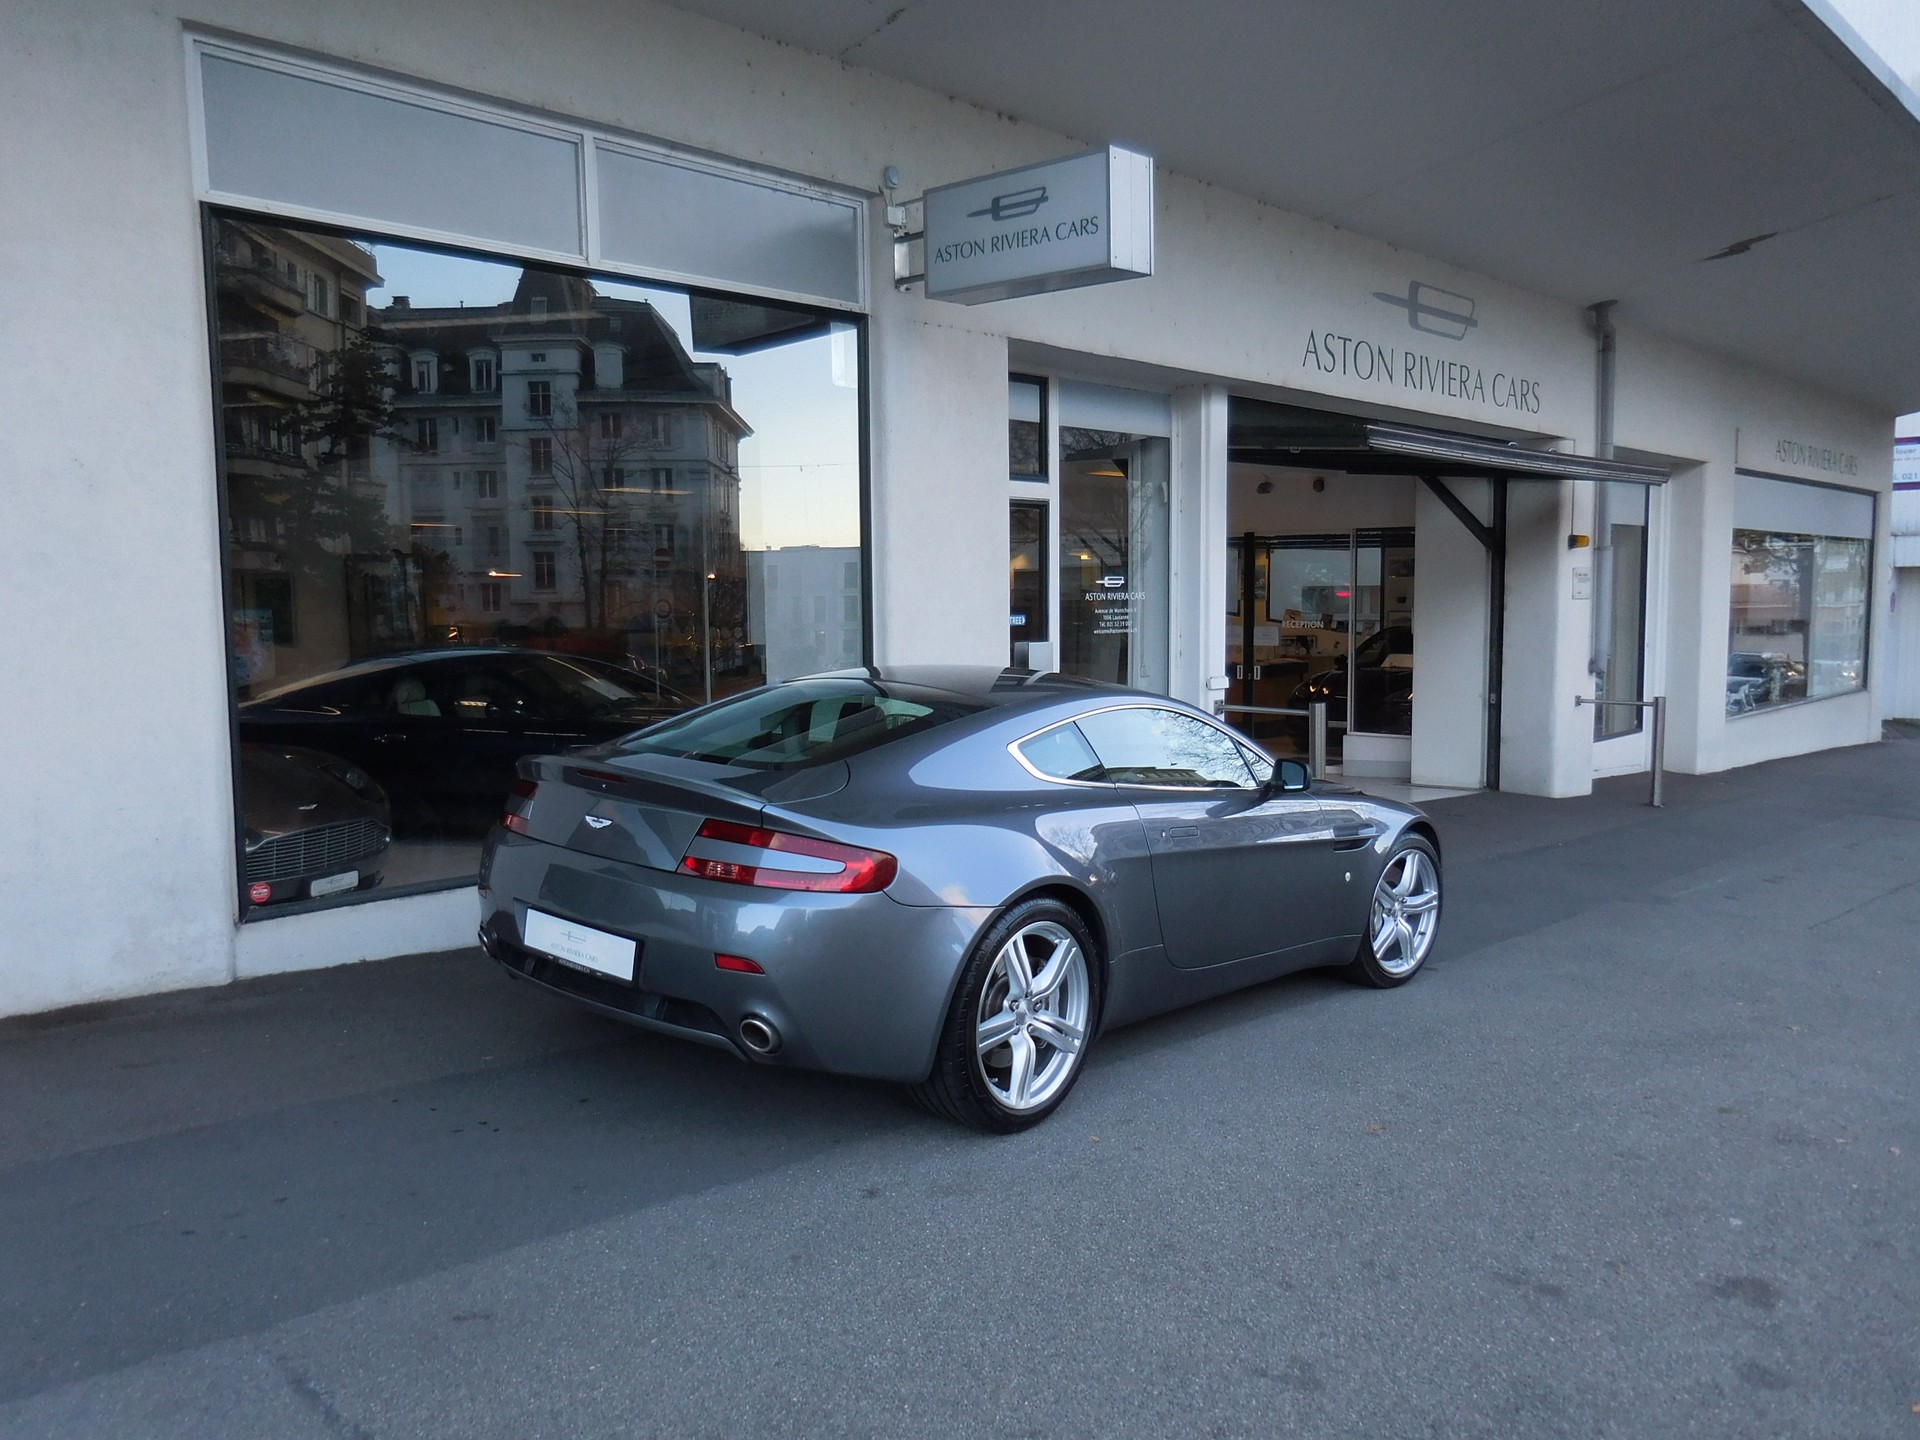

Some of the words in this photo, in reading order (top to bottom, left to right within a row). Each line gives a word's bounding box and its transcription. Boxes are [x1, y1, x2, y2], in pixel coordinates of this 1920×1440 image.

[934, 238, 985, 264] ASTON
[991, 226, 1051, 253] RIVIERA
[1055, 216, 1099, 241] CARS
[1302, 329, 1395, 385] ASTON
[1404, 351, 1486, 404] RIVIERA
[1492, 373, 1541, 414] CARS
[1775, 439, 1806, 466] ASTON
[1085, 592, 1106, 601] ASTON
[1107, 592, 1130, 601] RIVIERA
[1130, 591, 1146, 600] CARS
[1281, 620, 1324, 629] RECEPTION
